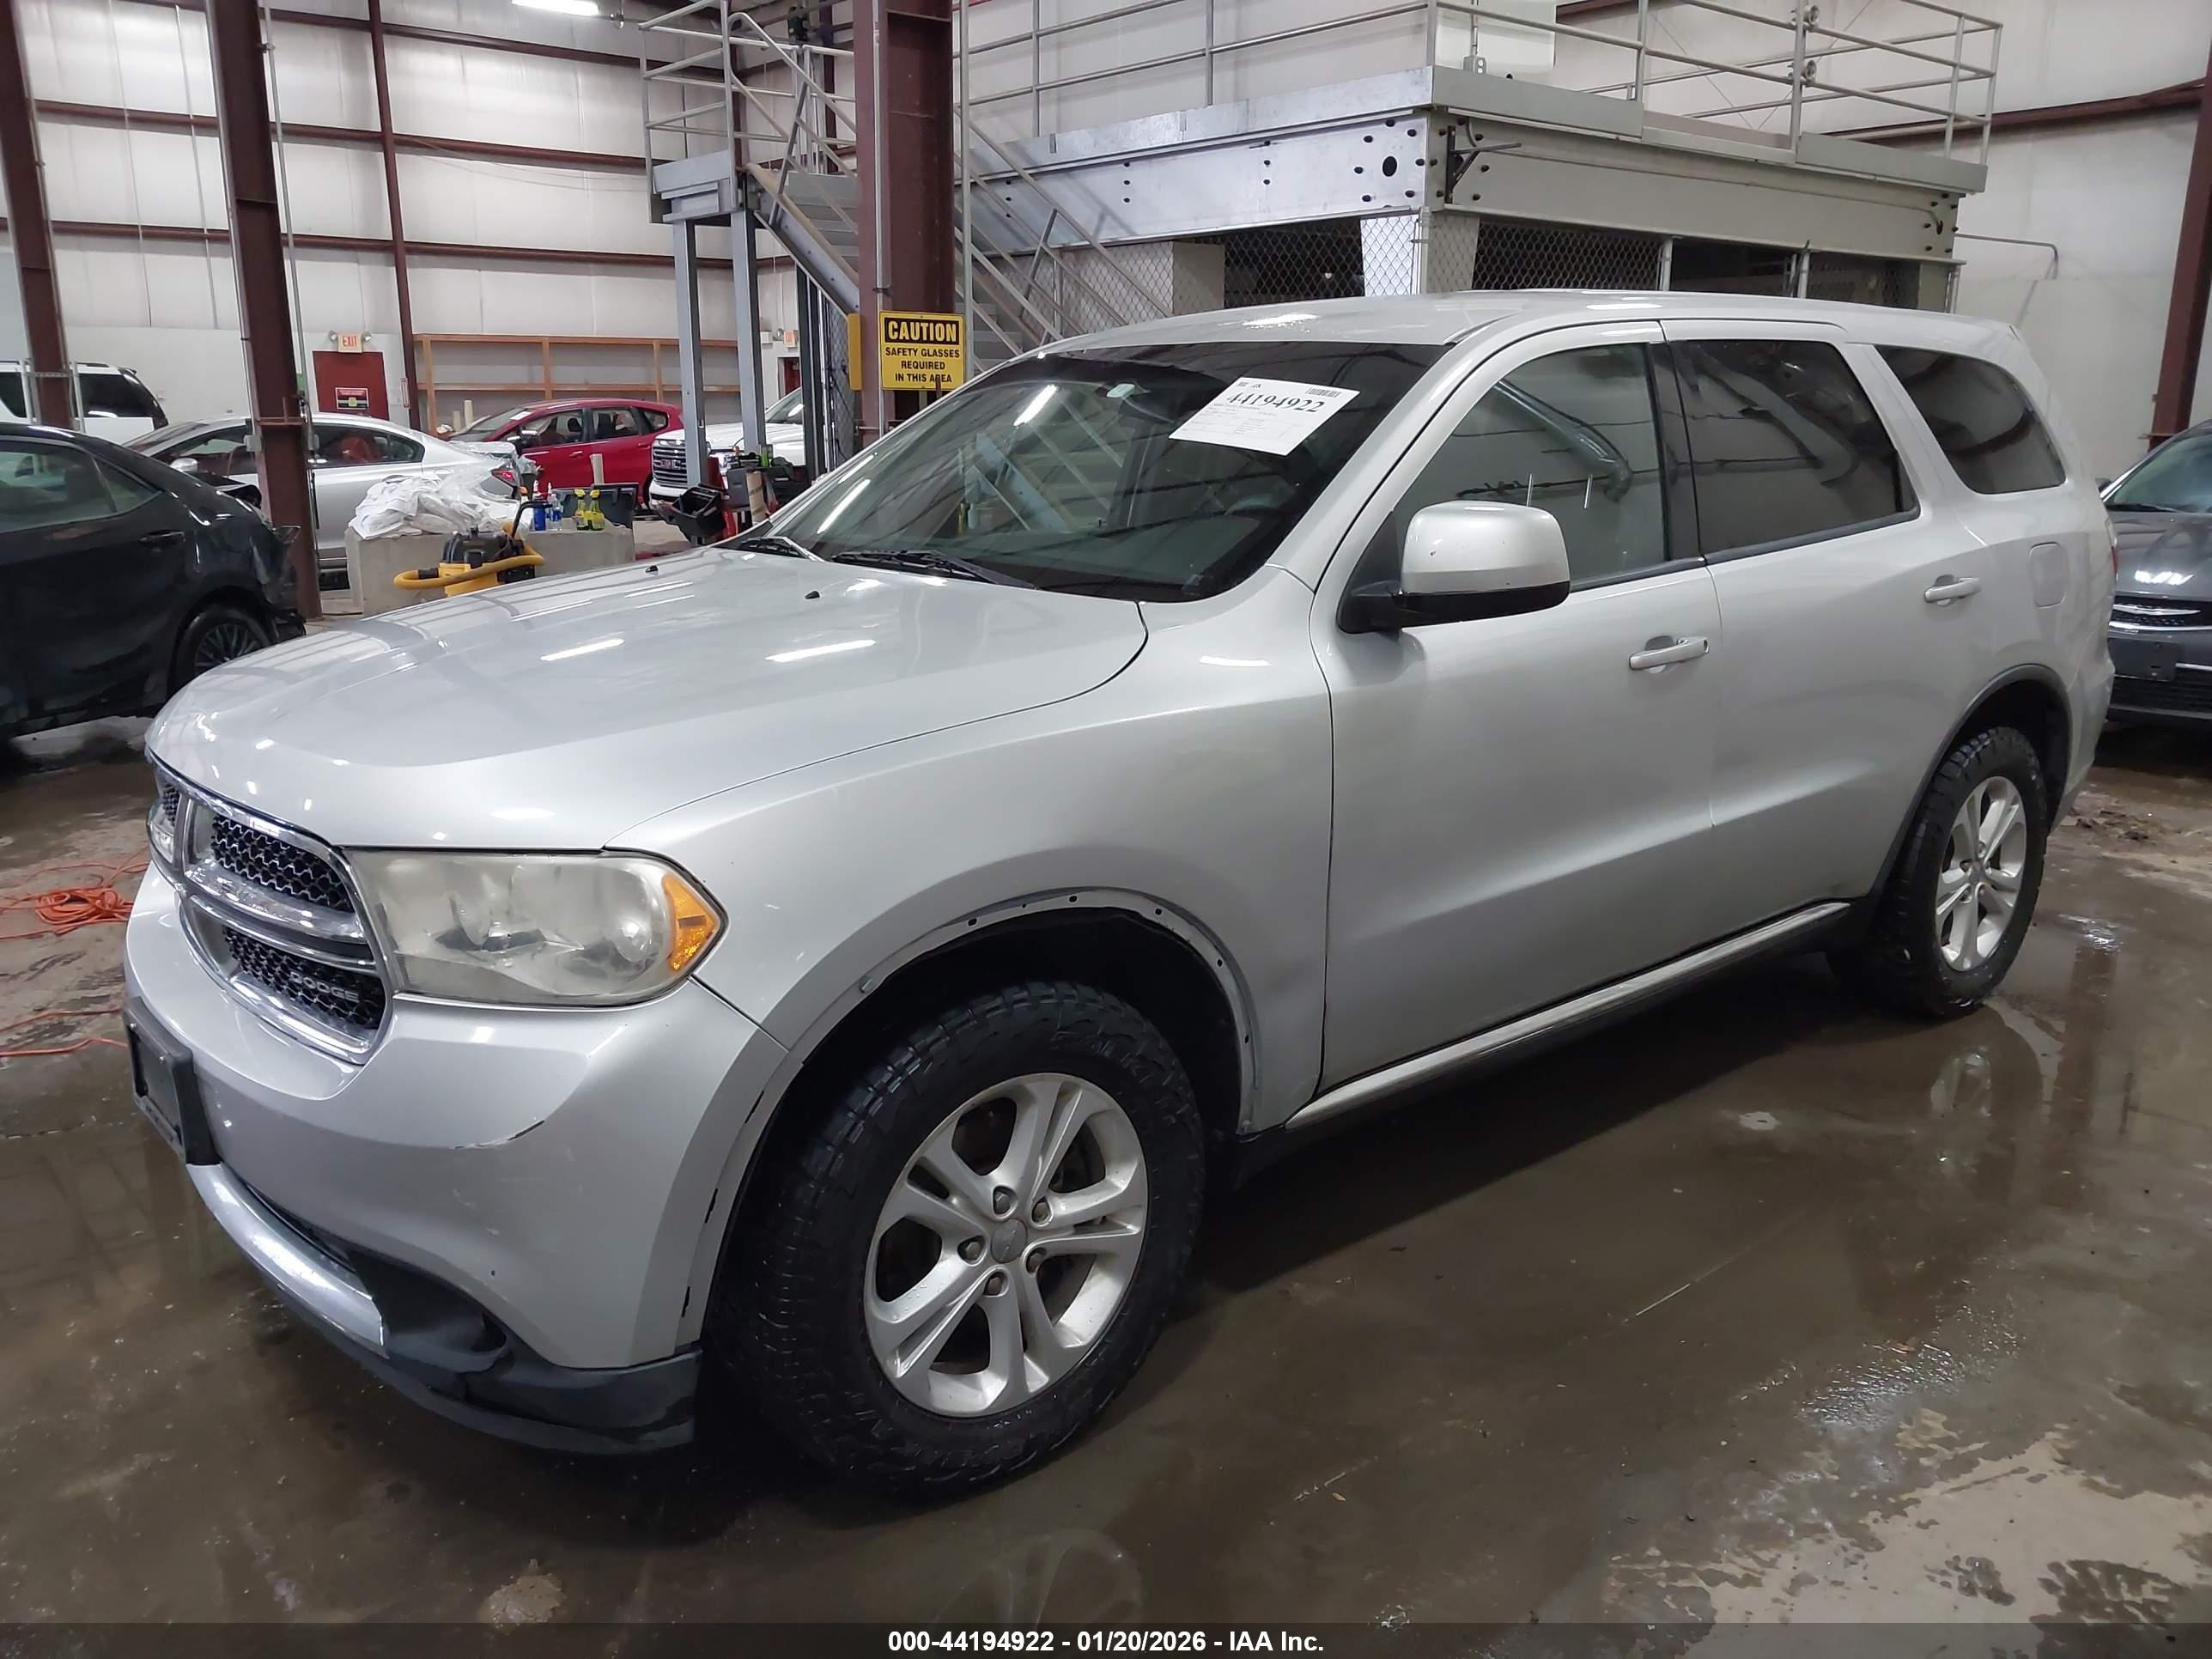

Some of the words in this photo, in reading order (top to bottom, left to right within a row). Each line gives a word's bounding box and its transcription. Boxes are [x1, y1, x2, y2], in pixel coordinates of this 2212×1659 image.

[888, 320, 957, 343] CAUTION
[342, 336, 357, 347] EXIT
[885, 347, 919, 357] SAFETY
[921, 348, 960, 358] GLASSES
[901, 361, 945, 370] REQUIRED
[895, 374, 904, 382] IN
[907, 374, 927, 382] THIS
[1226, 392, 1326, 413] 44194922
[289, 971, 360, 1003] DODGE
